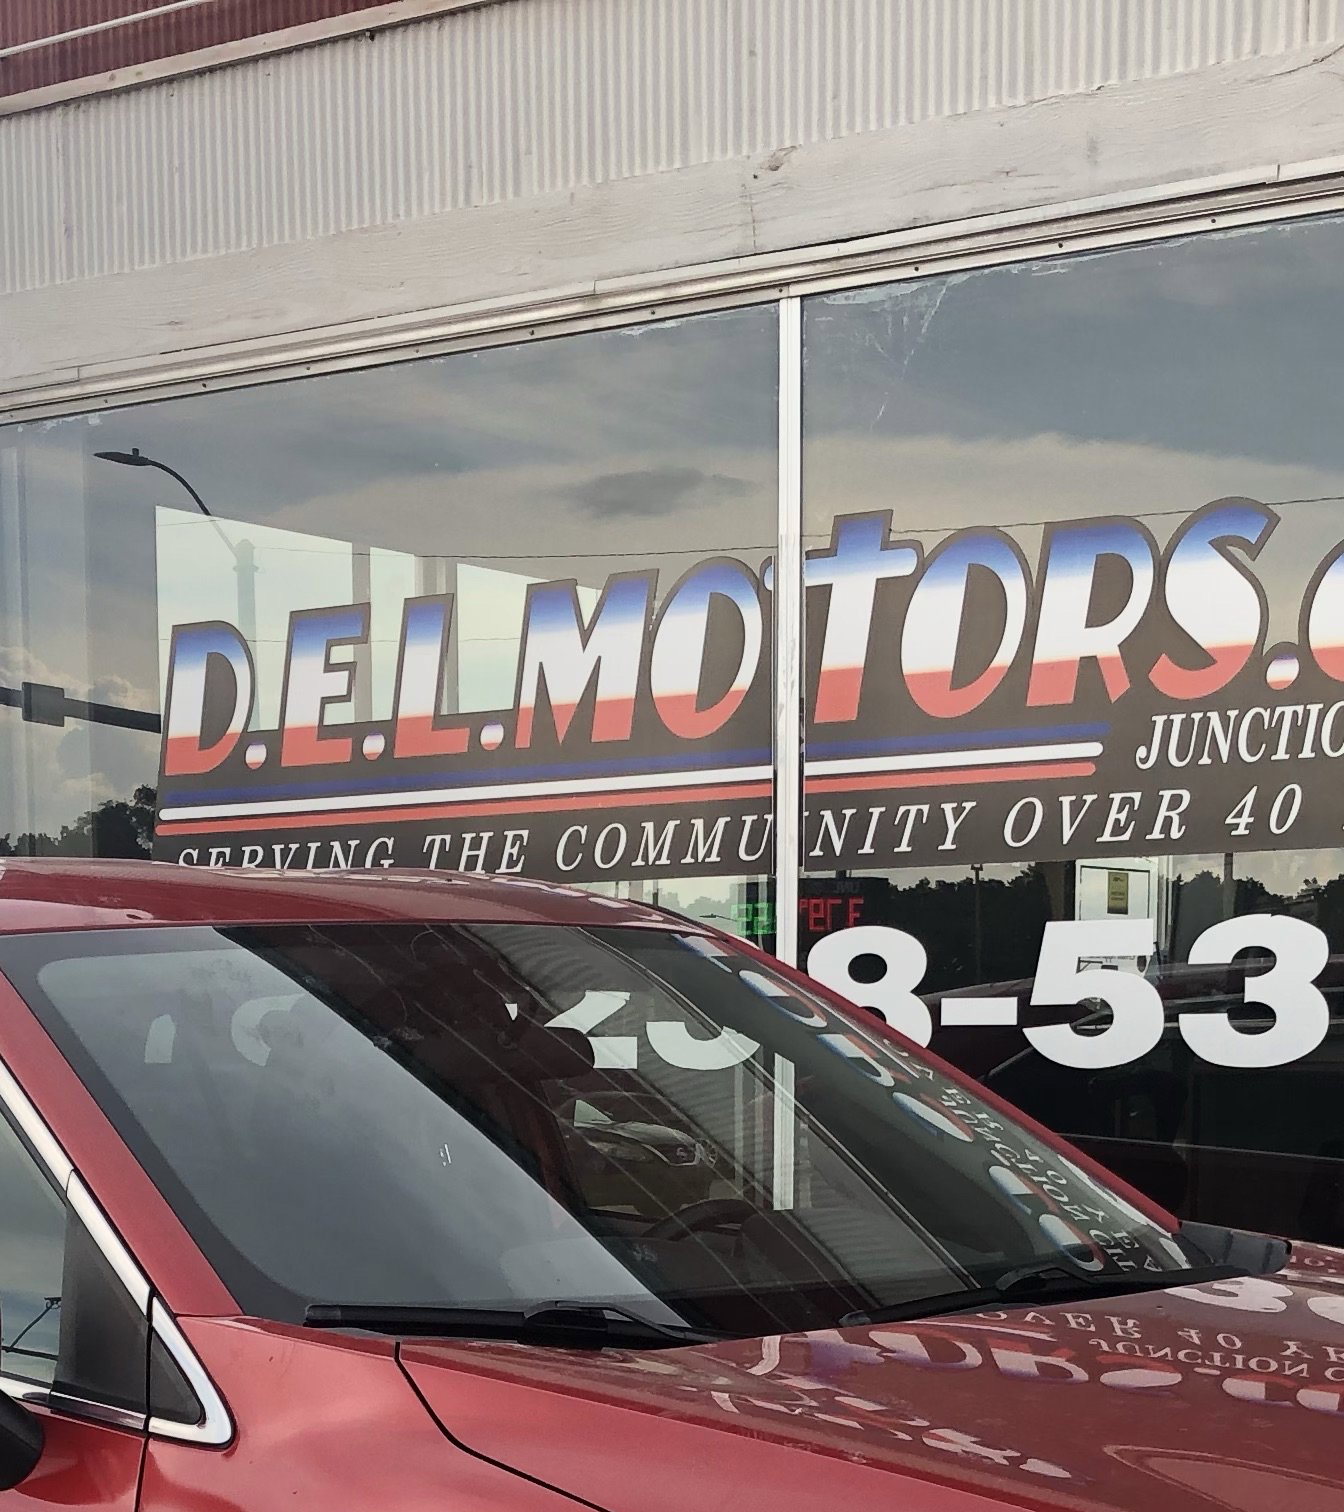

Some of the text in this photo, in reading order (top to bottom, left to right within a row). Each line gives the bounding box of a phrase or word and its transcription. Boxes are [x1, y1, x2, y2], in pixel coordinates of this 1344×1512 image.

[423, 829, 529, 874] THE
[555, 803, 982, 873] COMMUNITY
[1004, 790, 1190, 848] OVER
[1225, 783, 1304, 836] 40
